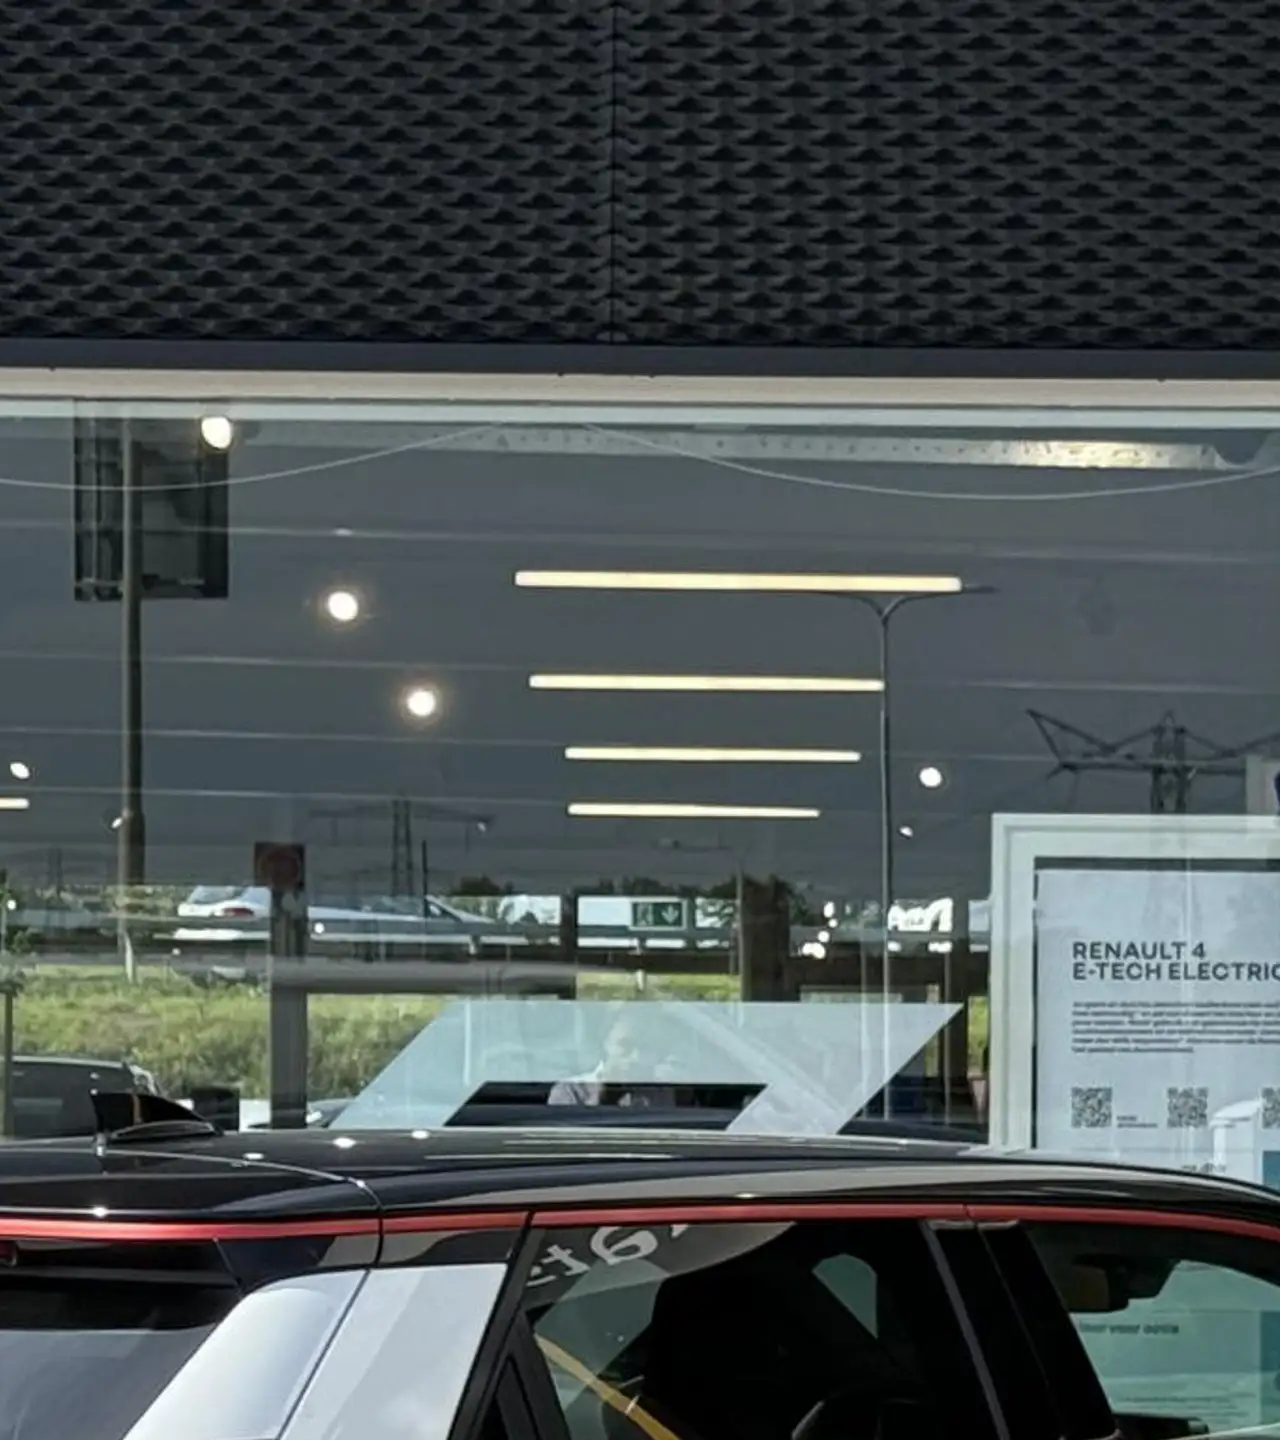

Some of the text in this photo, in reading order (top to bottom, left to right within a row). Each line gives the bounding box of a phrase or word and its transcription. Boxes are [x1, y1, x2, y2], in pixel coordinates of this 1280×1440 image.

[1071, 941, 1207, 960] RENAULT 4
[1071, 962, 1162, 981] E-TECH
